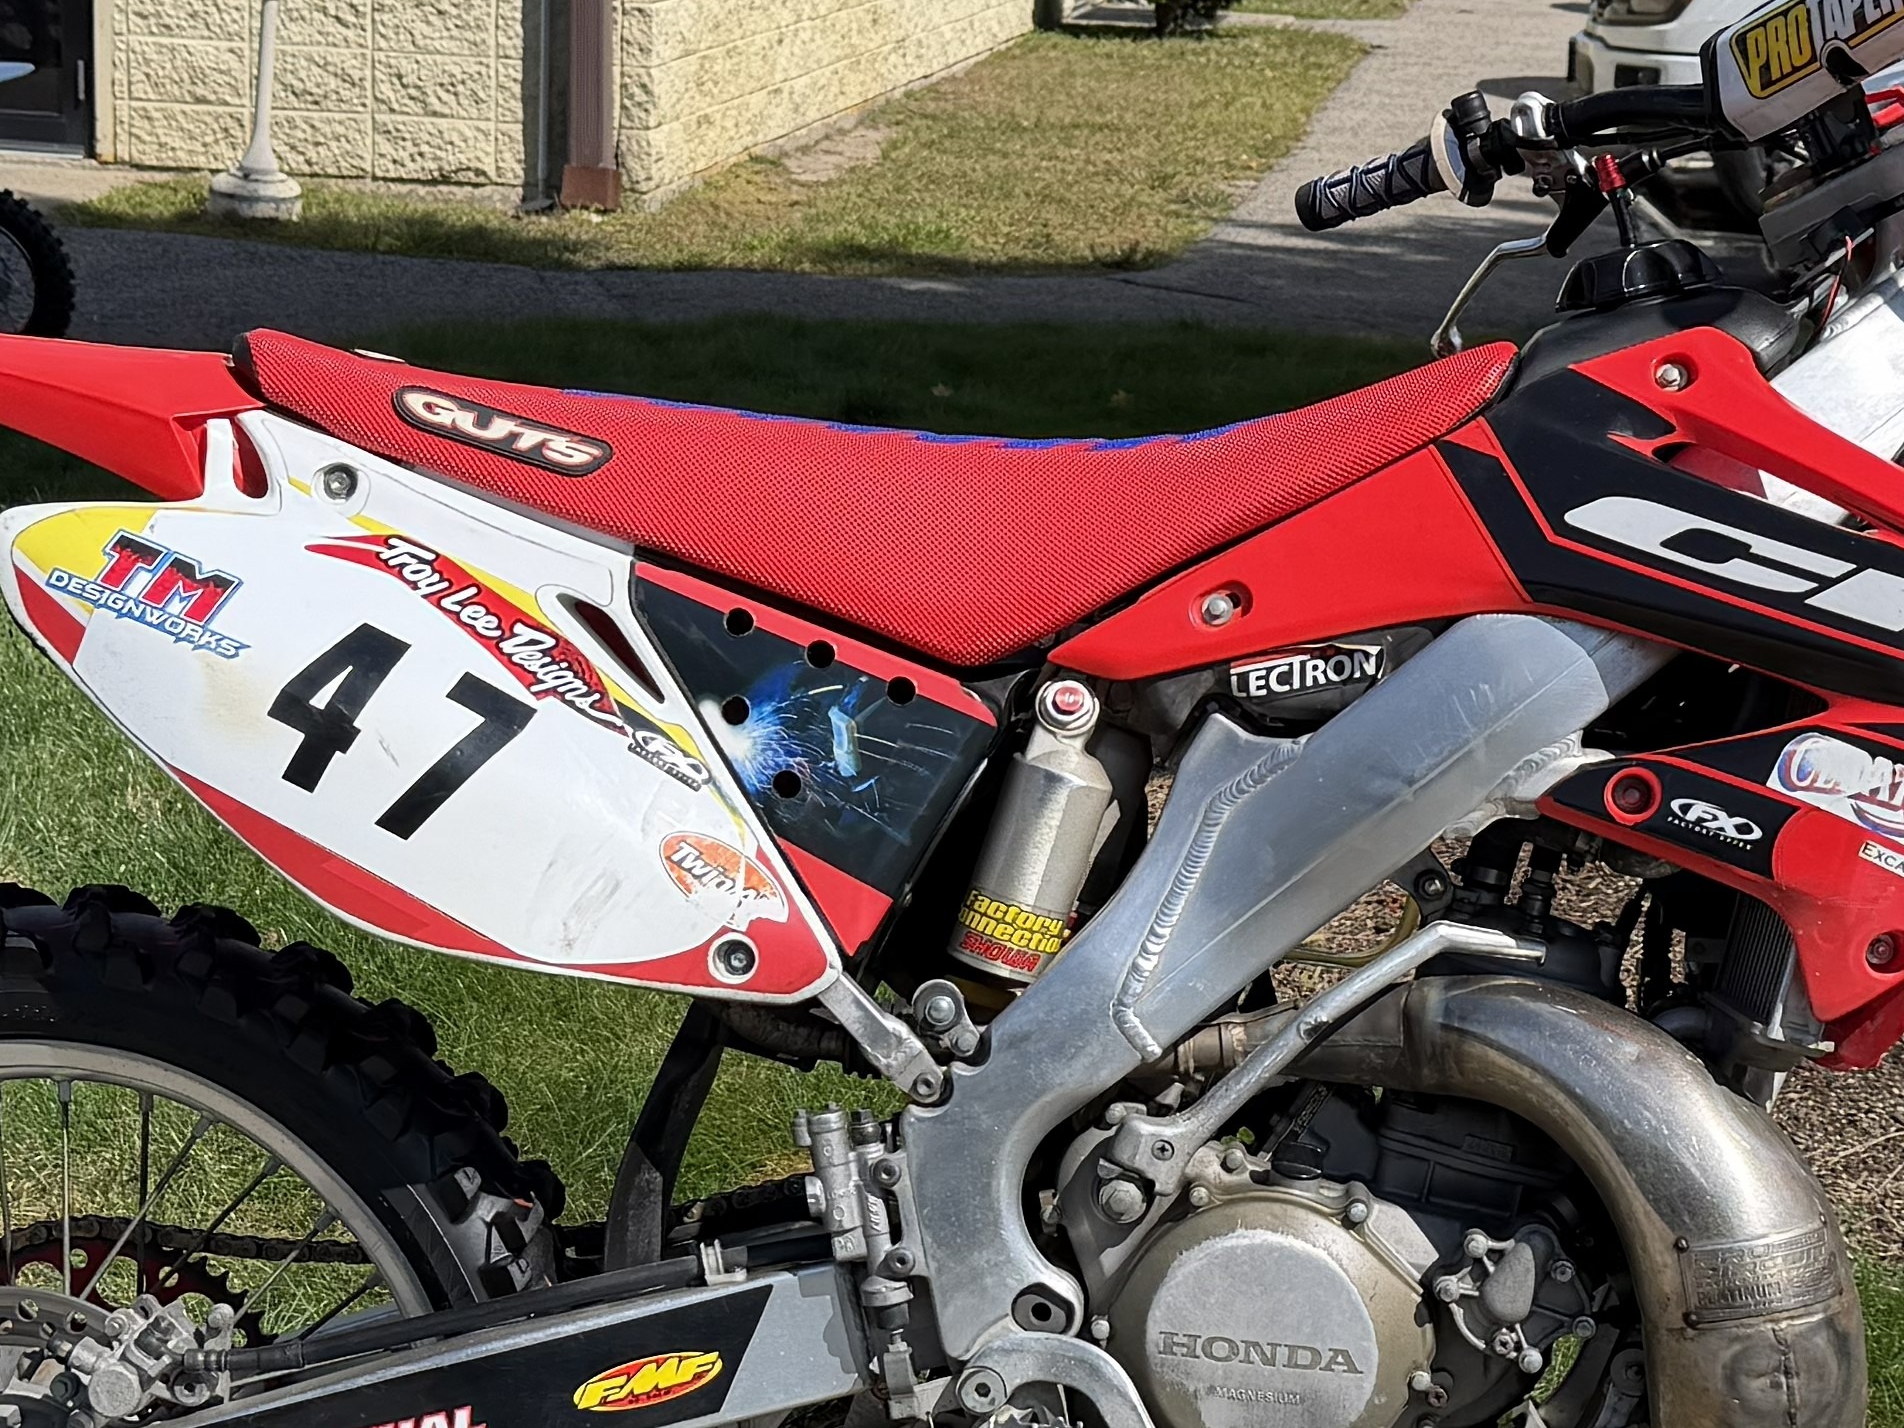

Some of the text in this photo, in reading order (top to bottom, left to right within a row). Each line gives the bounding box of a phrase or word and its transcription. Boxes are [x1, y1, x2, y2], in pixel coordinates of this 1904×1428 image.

[403, 392, 604, 466] GUTS
[49, 570, 241, 657] DESIGNWORKS
[99, 529, 243, 625] TM
[379, 537, 623, 726] Troy Lee Designs
[267, 622, 539, 841] 47
[966, 890, 1063, 936] Factory
[578, 1351, 719, 1409] FMF
[1158, 1331, 1364, 1375] HONDA
[1212, 1386, 1301, 1406] MAGNESIUM
